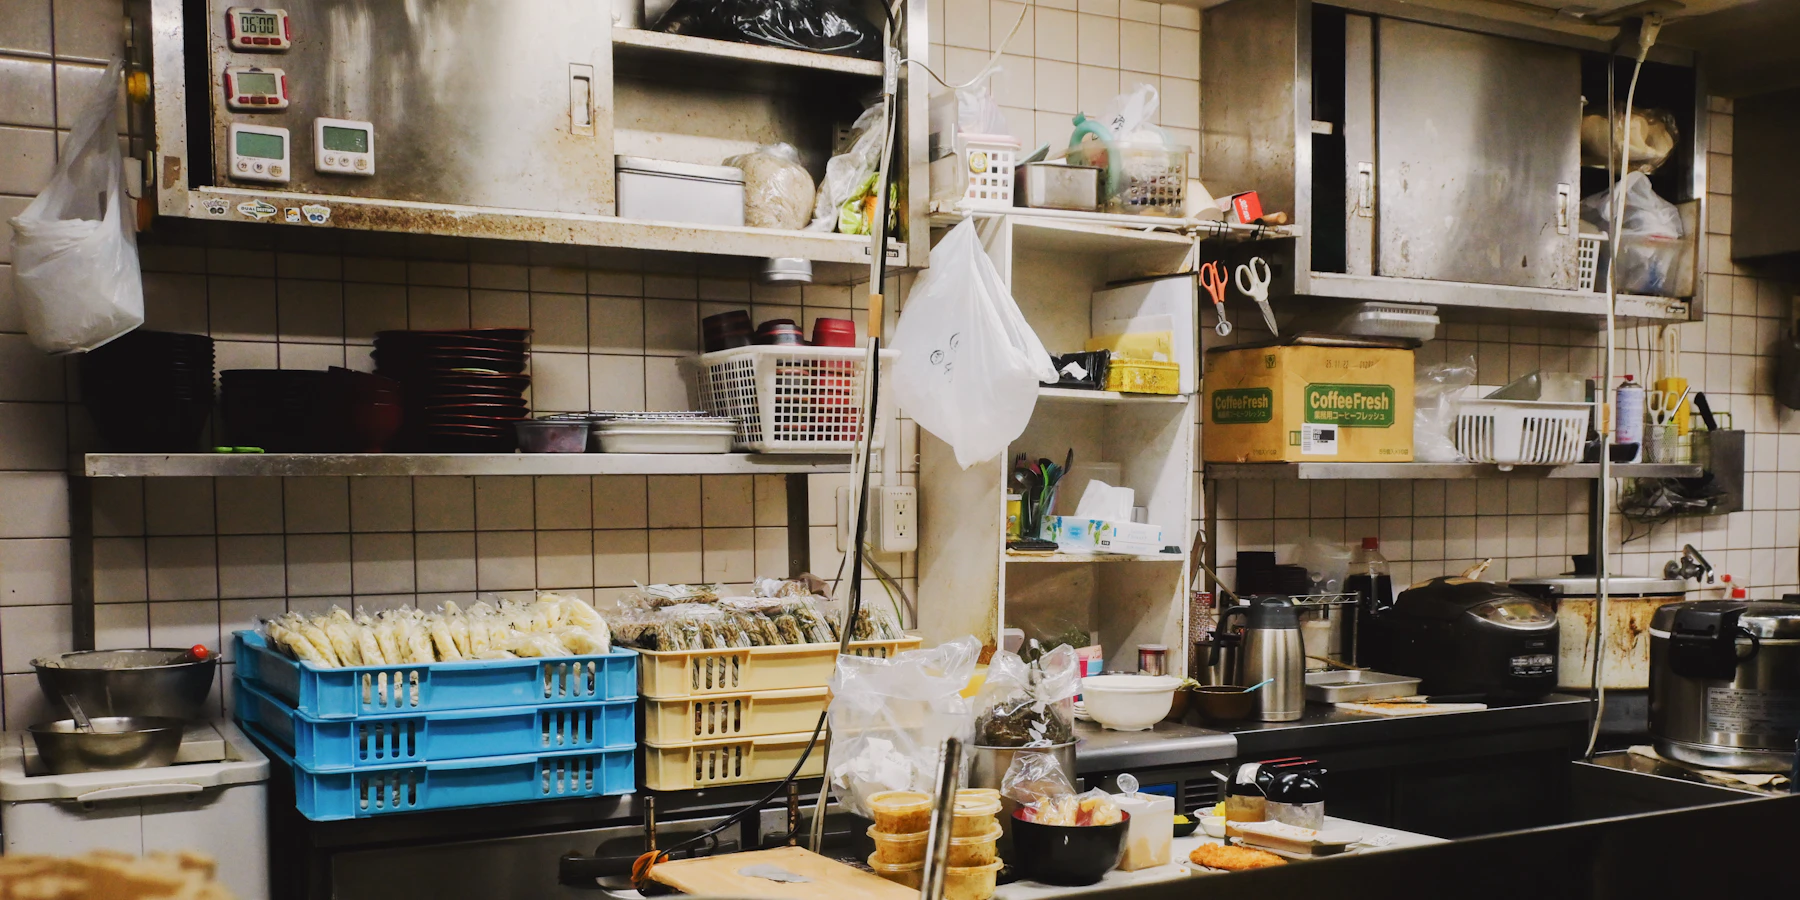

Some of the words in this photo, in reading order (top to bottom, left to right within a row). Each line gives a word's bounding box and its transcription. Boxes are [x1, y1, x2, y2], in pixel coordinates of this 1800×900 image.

[242, 16, 273, 33] 06:00
[1314, 411, 1385, 420] 業務用コーヒーフレッシュ
